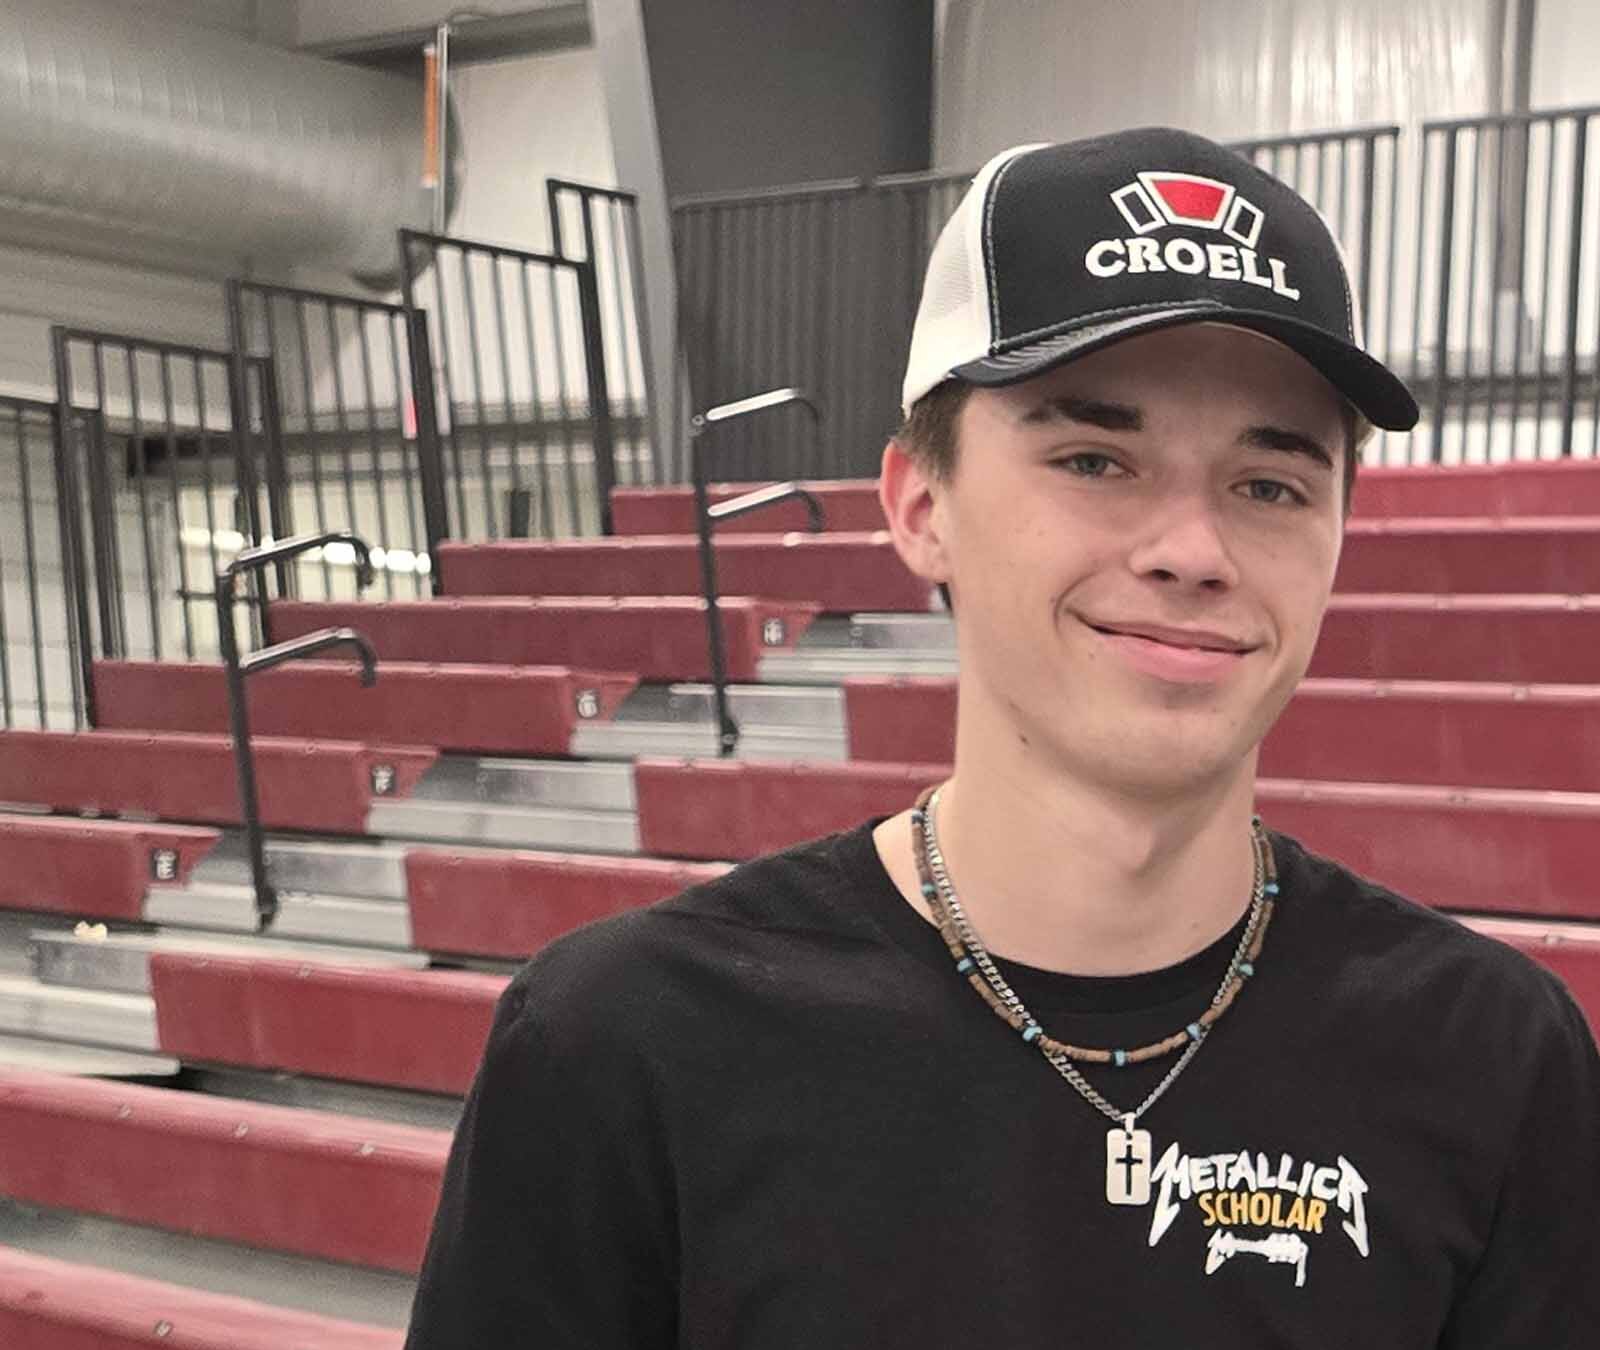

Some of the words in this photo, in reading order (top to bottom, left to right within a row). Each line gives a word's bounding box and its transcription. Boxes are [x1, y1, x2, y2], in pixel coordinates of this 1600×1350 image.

[1084, 237, 1301, 302] CROELL
[1148, 1141, 1370, 1258] METALLICA
[1199, 1190, 1328, 1234] SCHOLAR
